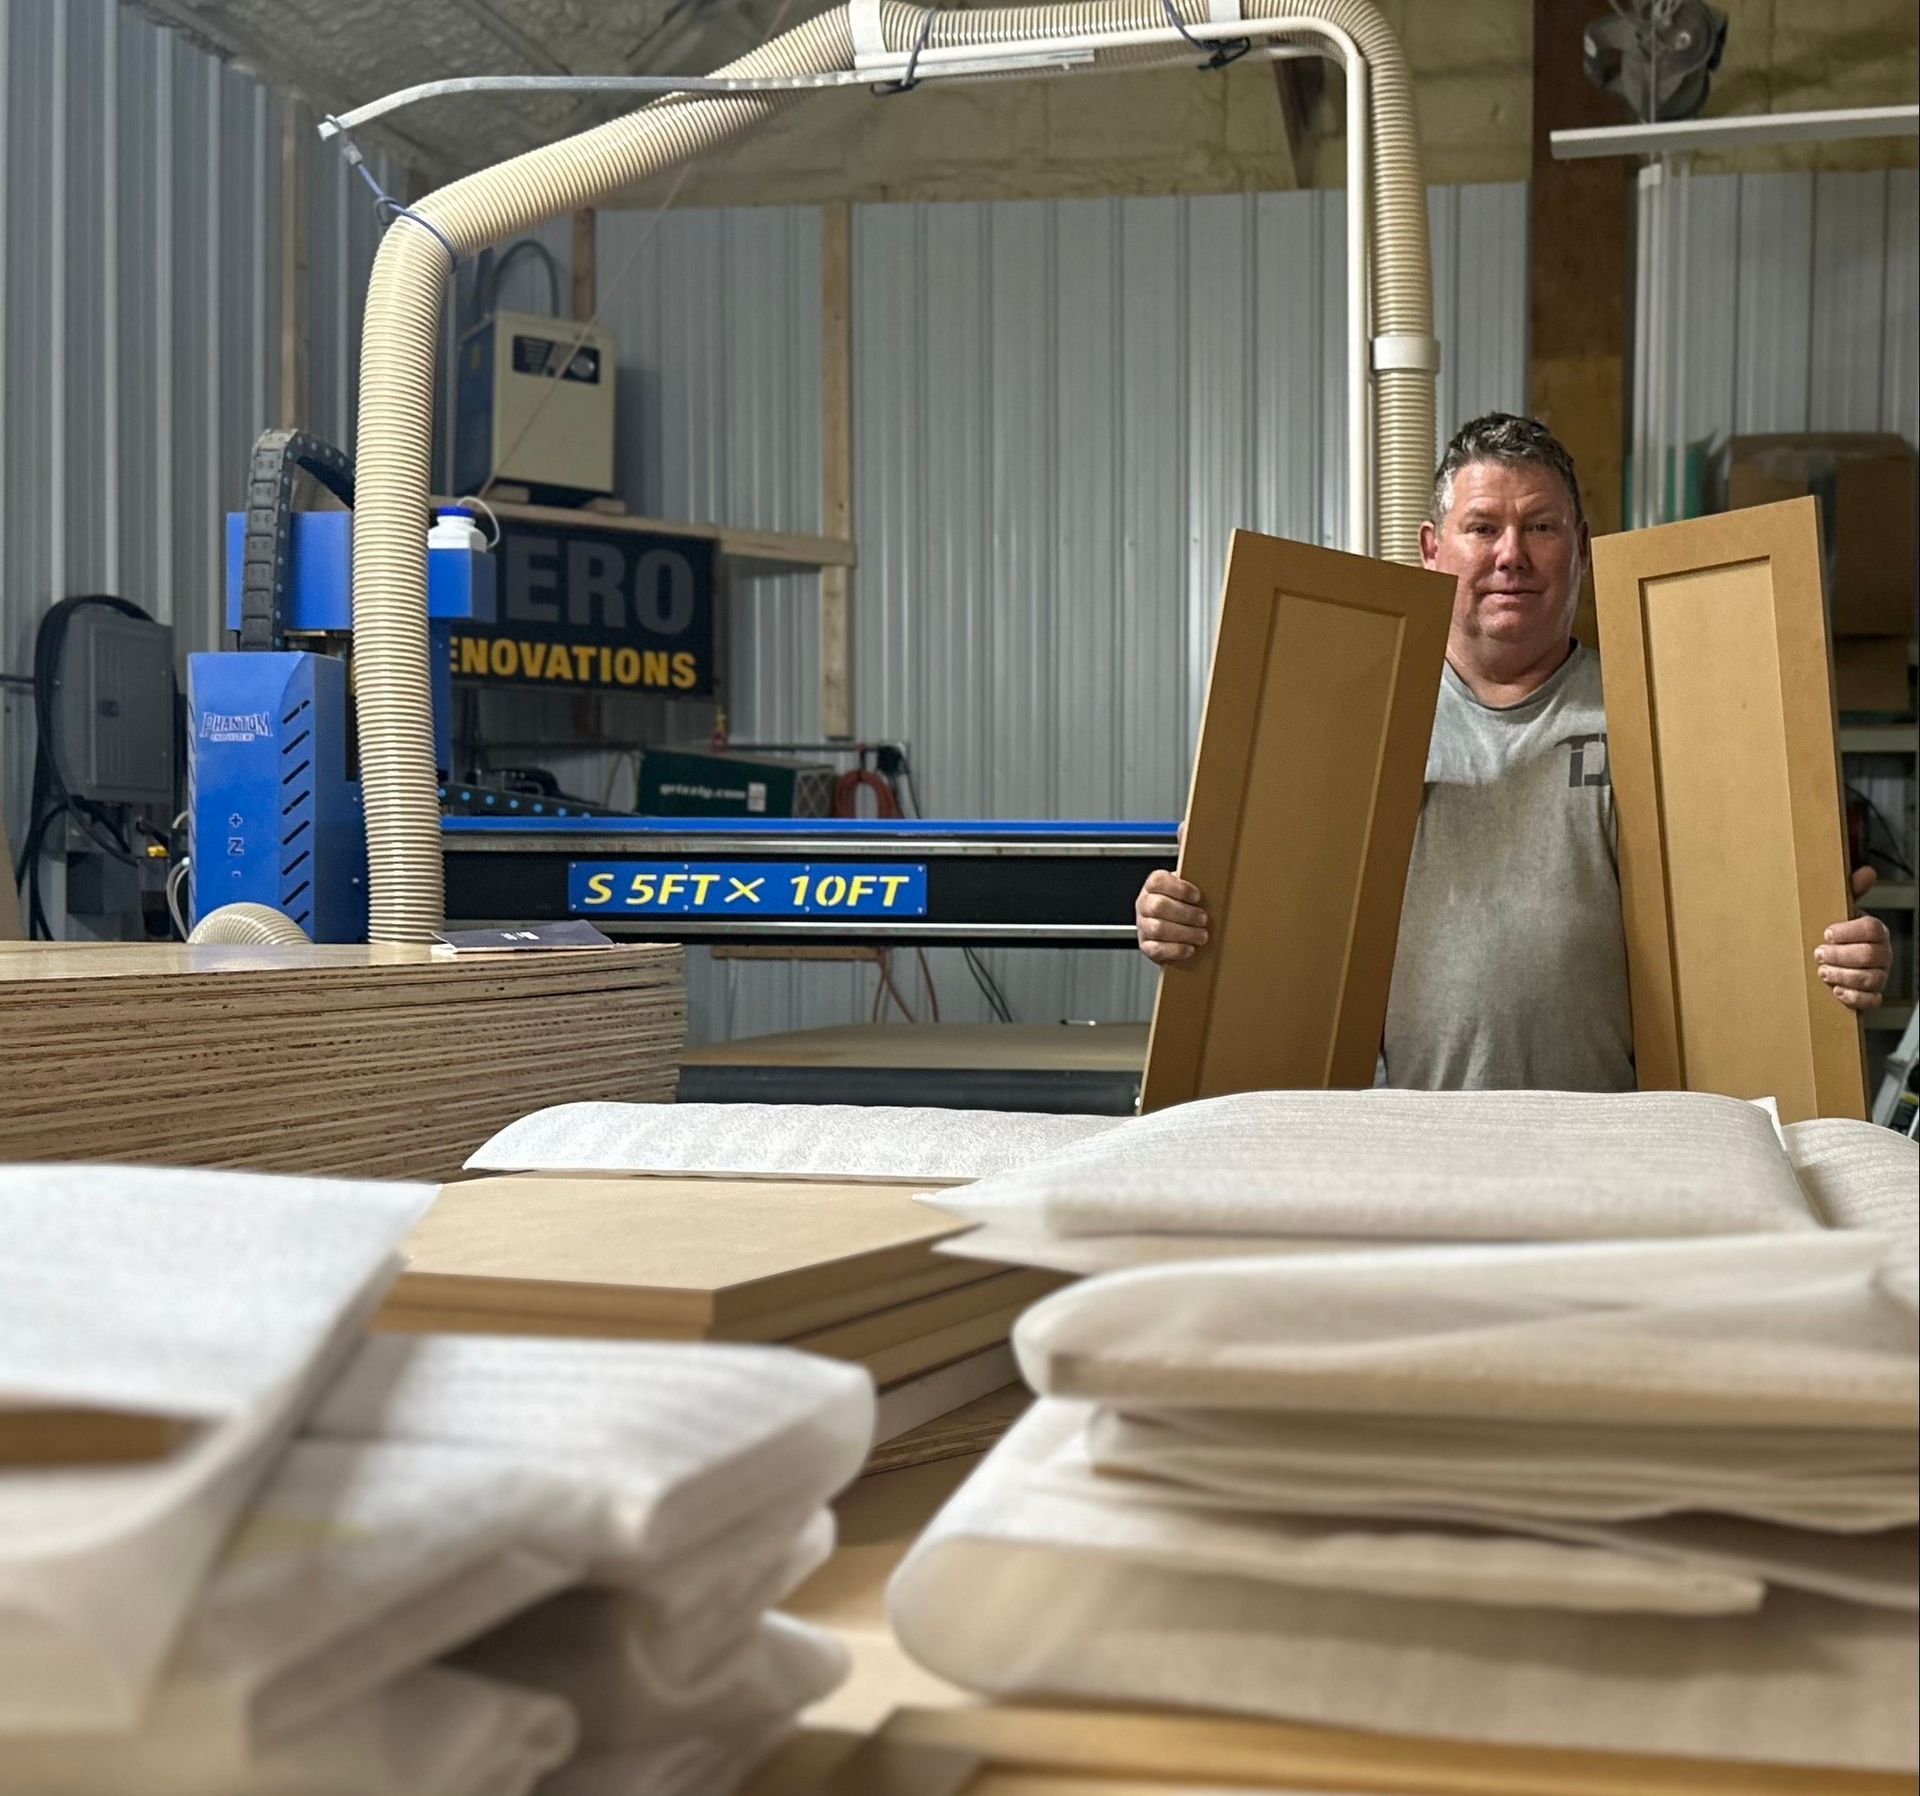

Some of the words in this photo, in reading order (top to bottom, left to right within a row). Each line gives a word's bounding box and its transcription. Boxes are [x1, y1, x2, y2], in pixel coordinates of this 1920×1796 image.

[200, 711, 274, 737] PHANTOM
[584, 873, 615, 905] S
[790, 875, 910, 907] 10FT
